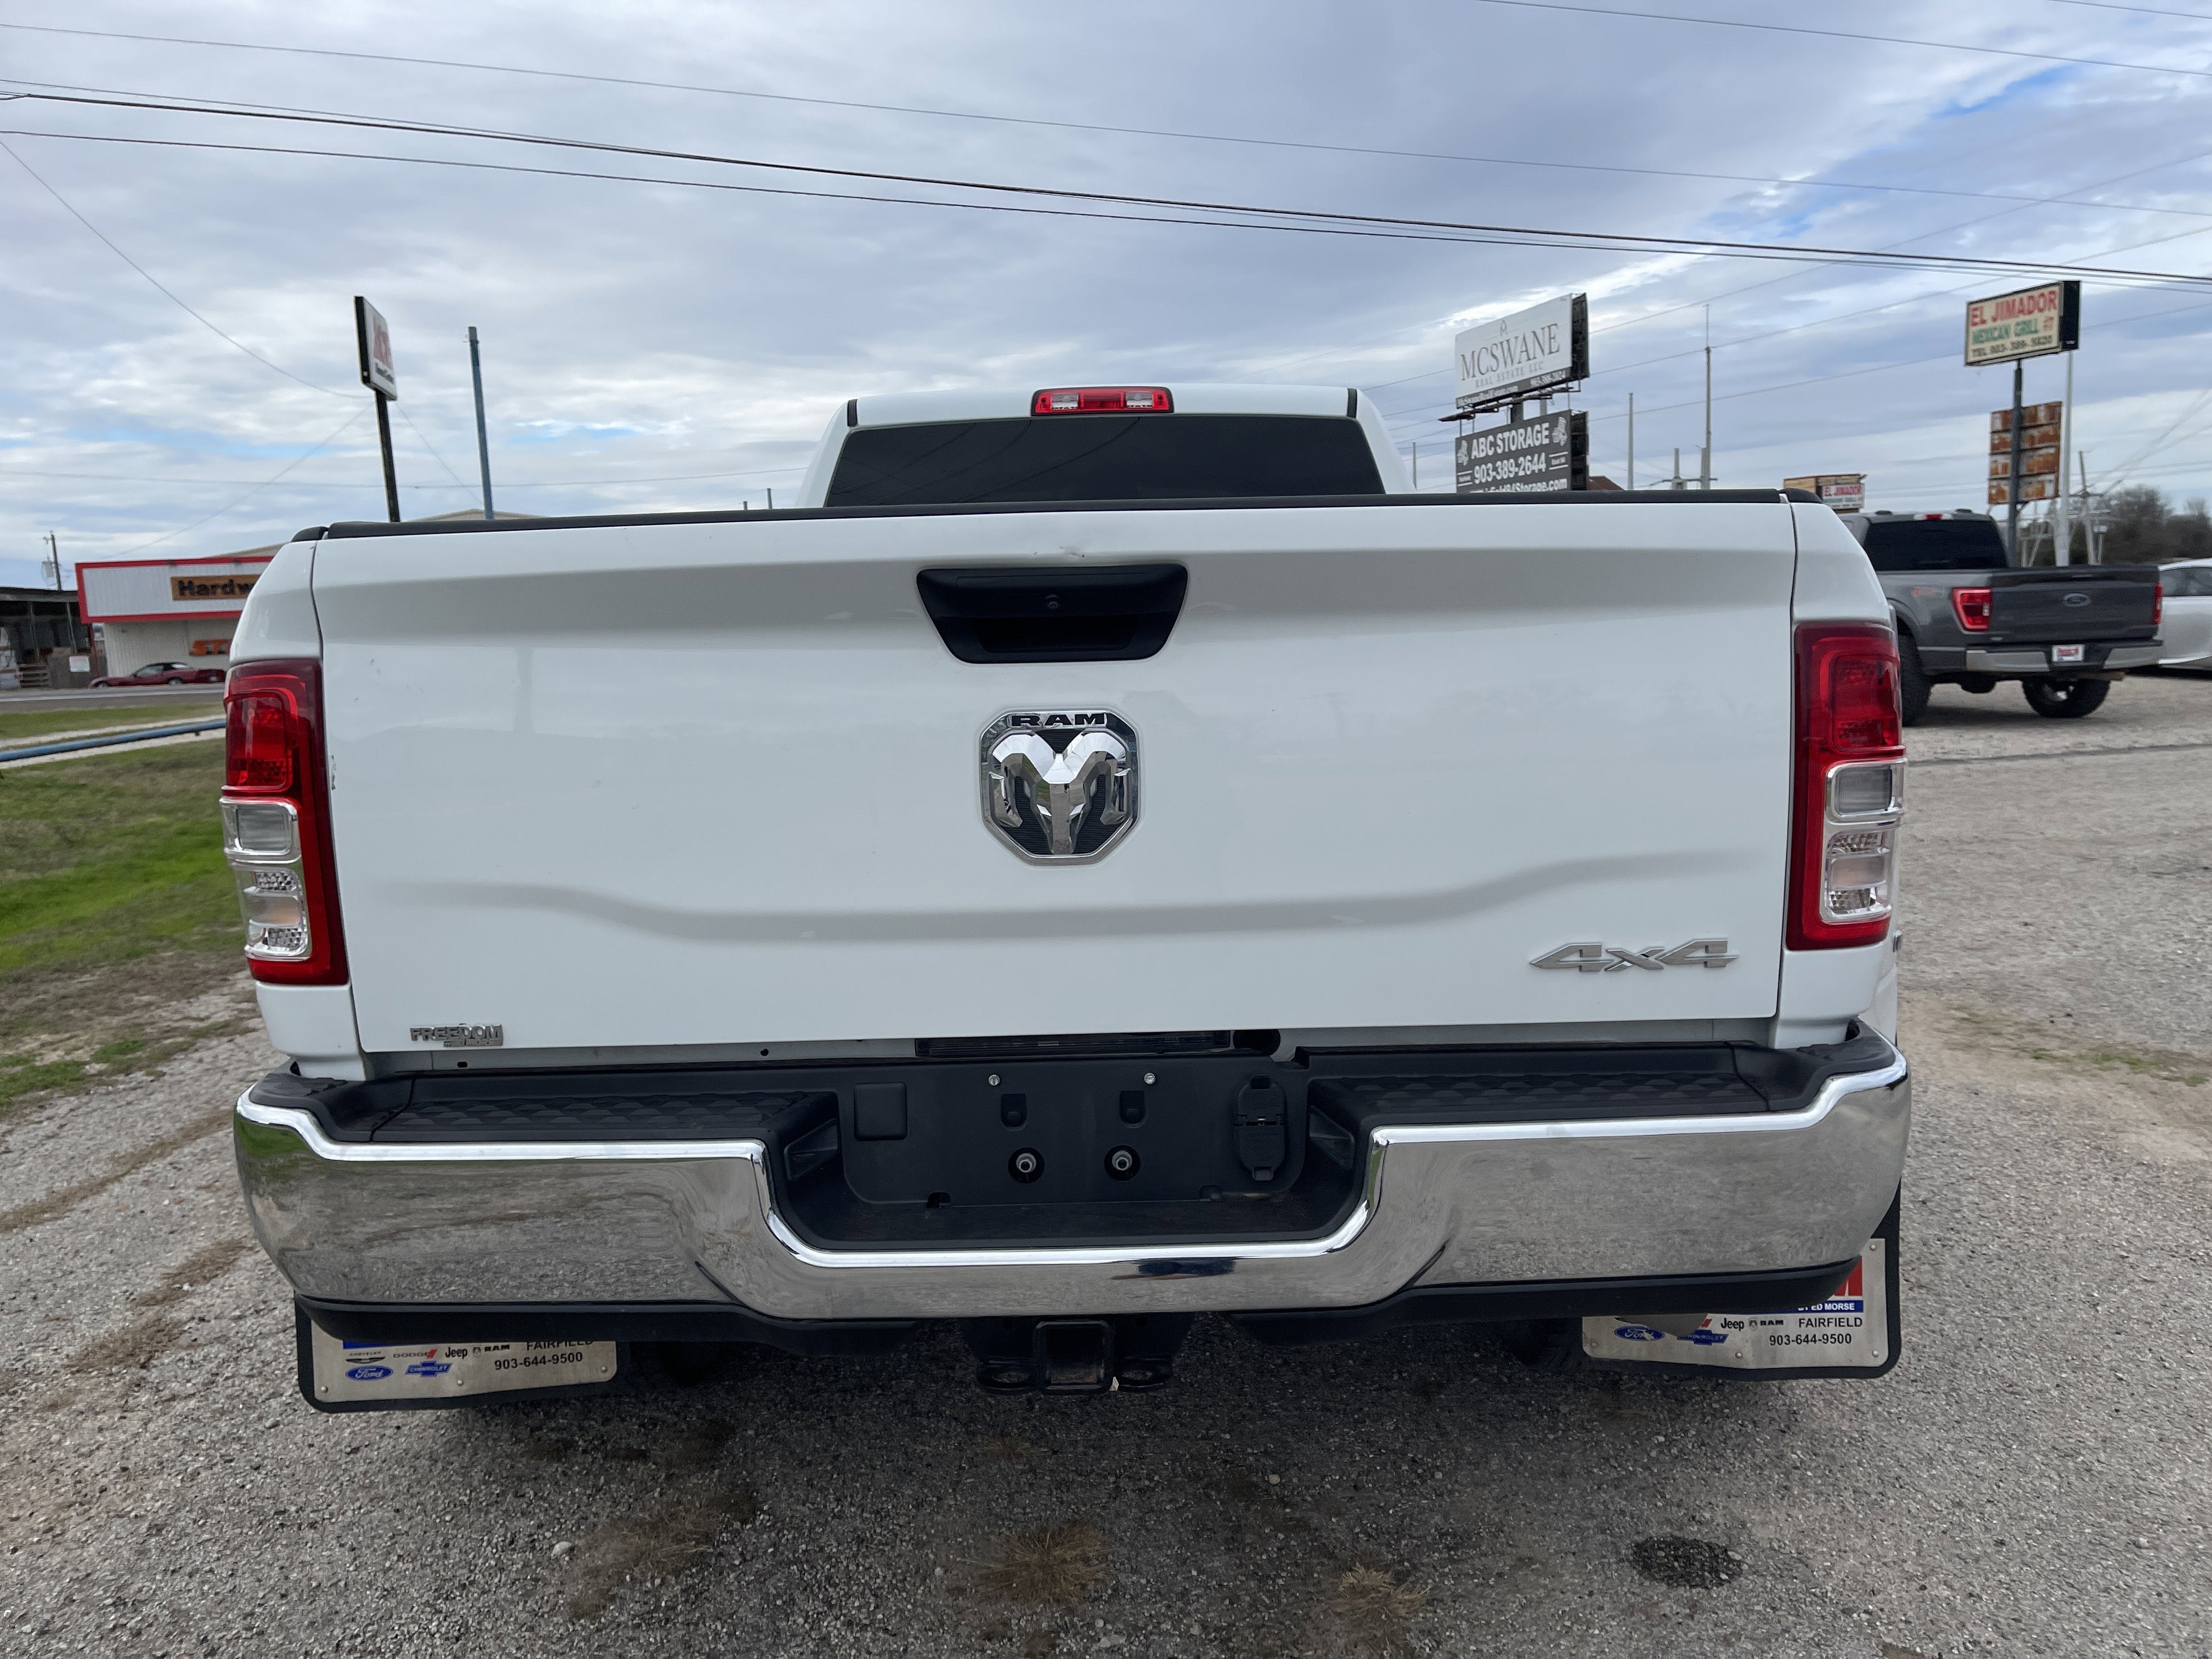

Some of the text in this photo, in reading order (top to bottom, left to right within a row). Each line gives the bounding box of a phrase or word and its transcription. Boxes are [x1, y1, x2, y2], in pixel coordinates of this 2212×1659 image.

[1970, 290, 2057, 327] EL JIMADOR
[1460, 323, 1560, 381] MCSWANE
[1496, 366, 1524, 381] ESTATE
[1528, 361, 1544, 373] LLC
[1471, 422, 1550, 459] ABC STORAGE
[1474, 452, 1547, 484] 903-389-2644
[1011, 713, 1105, 727] RAM
[1824, 1302, 1855, 1311] MORSE
[1720, 1317, 1745, 1331] Jeep
[1798, 1317, 1863, 1328] FAIRFIELD
[1769, 1334, 1852, 1346] 903-644-9500
[445, 1347, 467, 1359] Jeep
[484, 1344, 510, 1352] RAM
[494, 1352, 583, 1370] 903-644-9500
[354, 1367, 383, 1379] Ford
